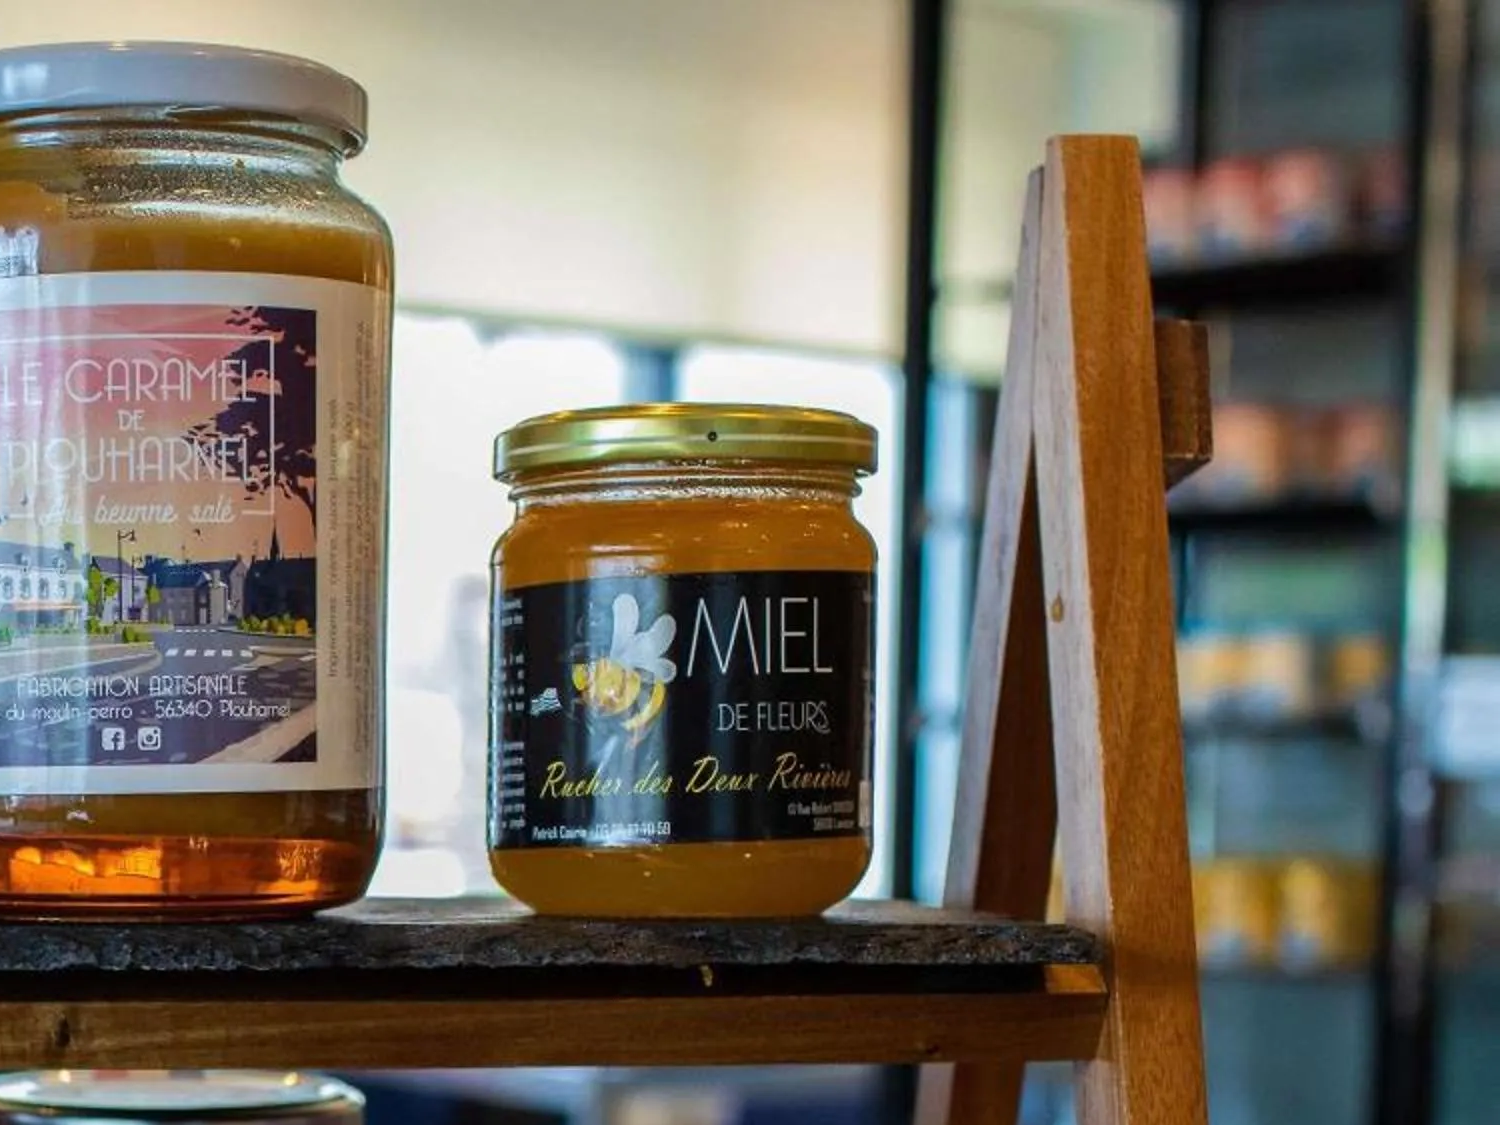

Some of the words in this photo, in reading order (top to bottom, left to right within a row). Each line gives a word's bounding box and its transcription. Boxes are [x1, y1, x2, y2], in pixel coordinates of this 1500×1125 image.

[0, 361, 43, 405] LE
[65, 356, 257, 404] CARAMEL
[118, 409, 145, 431] DE
[3, 435, 259, 485] PLOUHARNEL
[94, 495, 178, 525] beurre
[188, 495, 236, 524] salé
[686, 596, 833, 678] MIEL
[17, 675, 139, 698] FABRICATION
[149, 674, 248, 697] ARTISANALE
[6, 703, 25, 721] du
[154, 699, 213, 719] 56340
[717, 702, 749, 732] DE
[756, 701, 831, 733] FLEURS
[539, 760, 628, 800] Rucher
[630, 760, 673, 797] des
[685, 755, 760, 794] Deux
